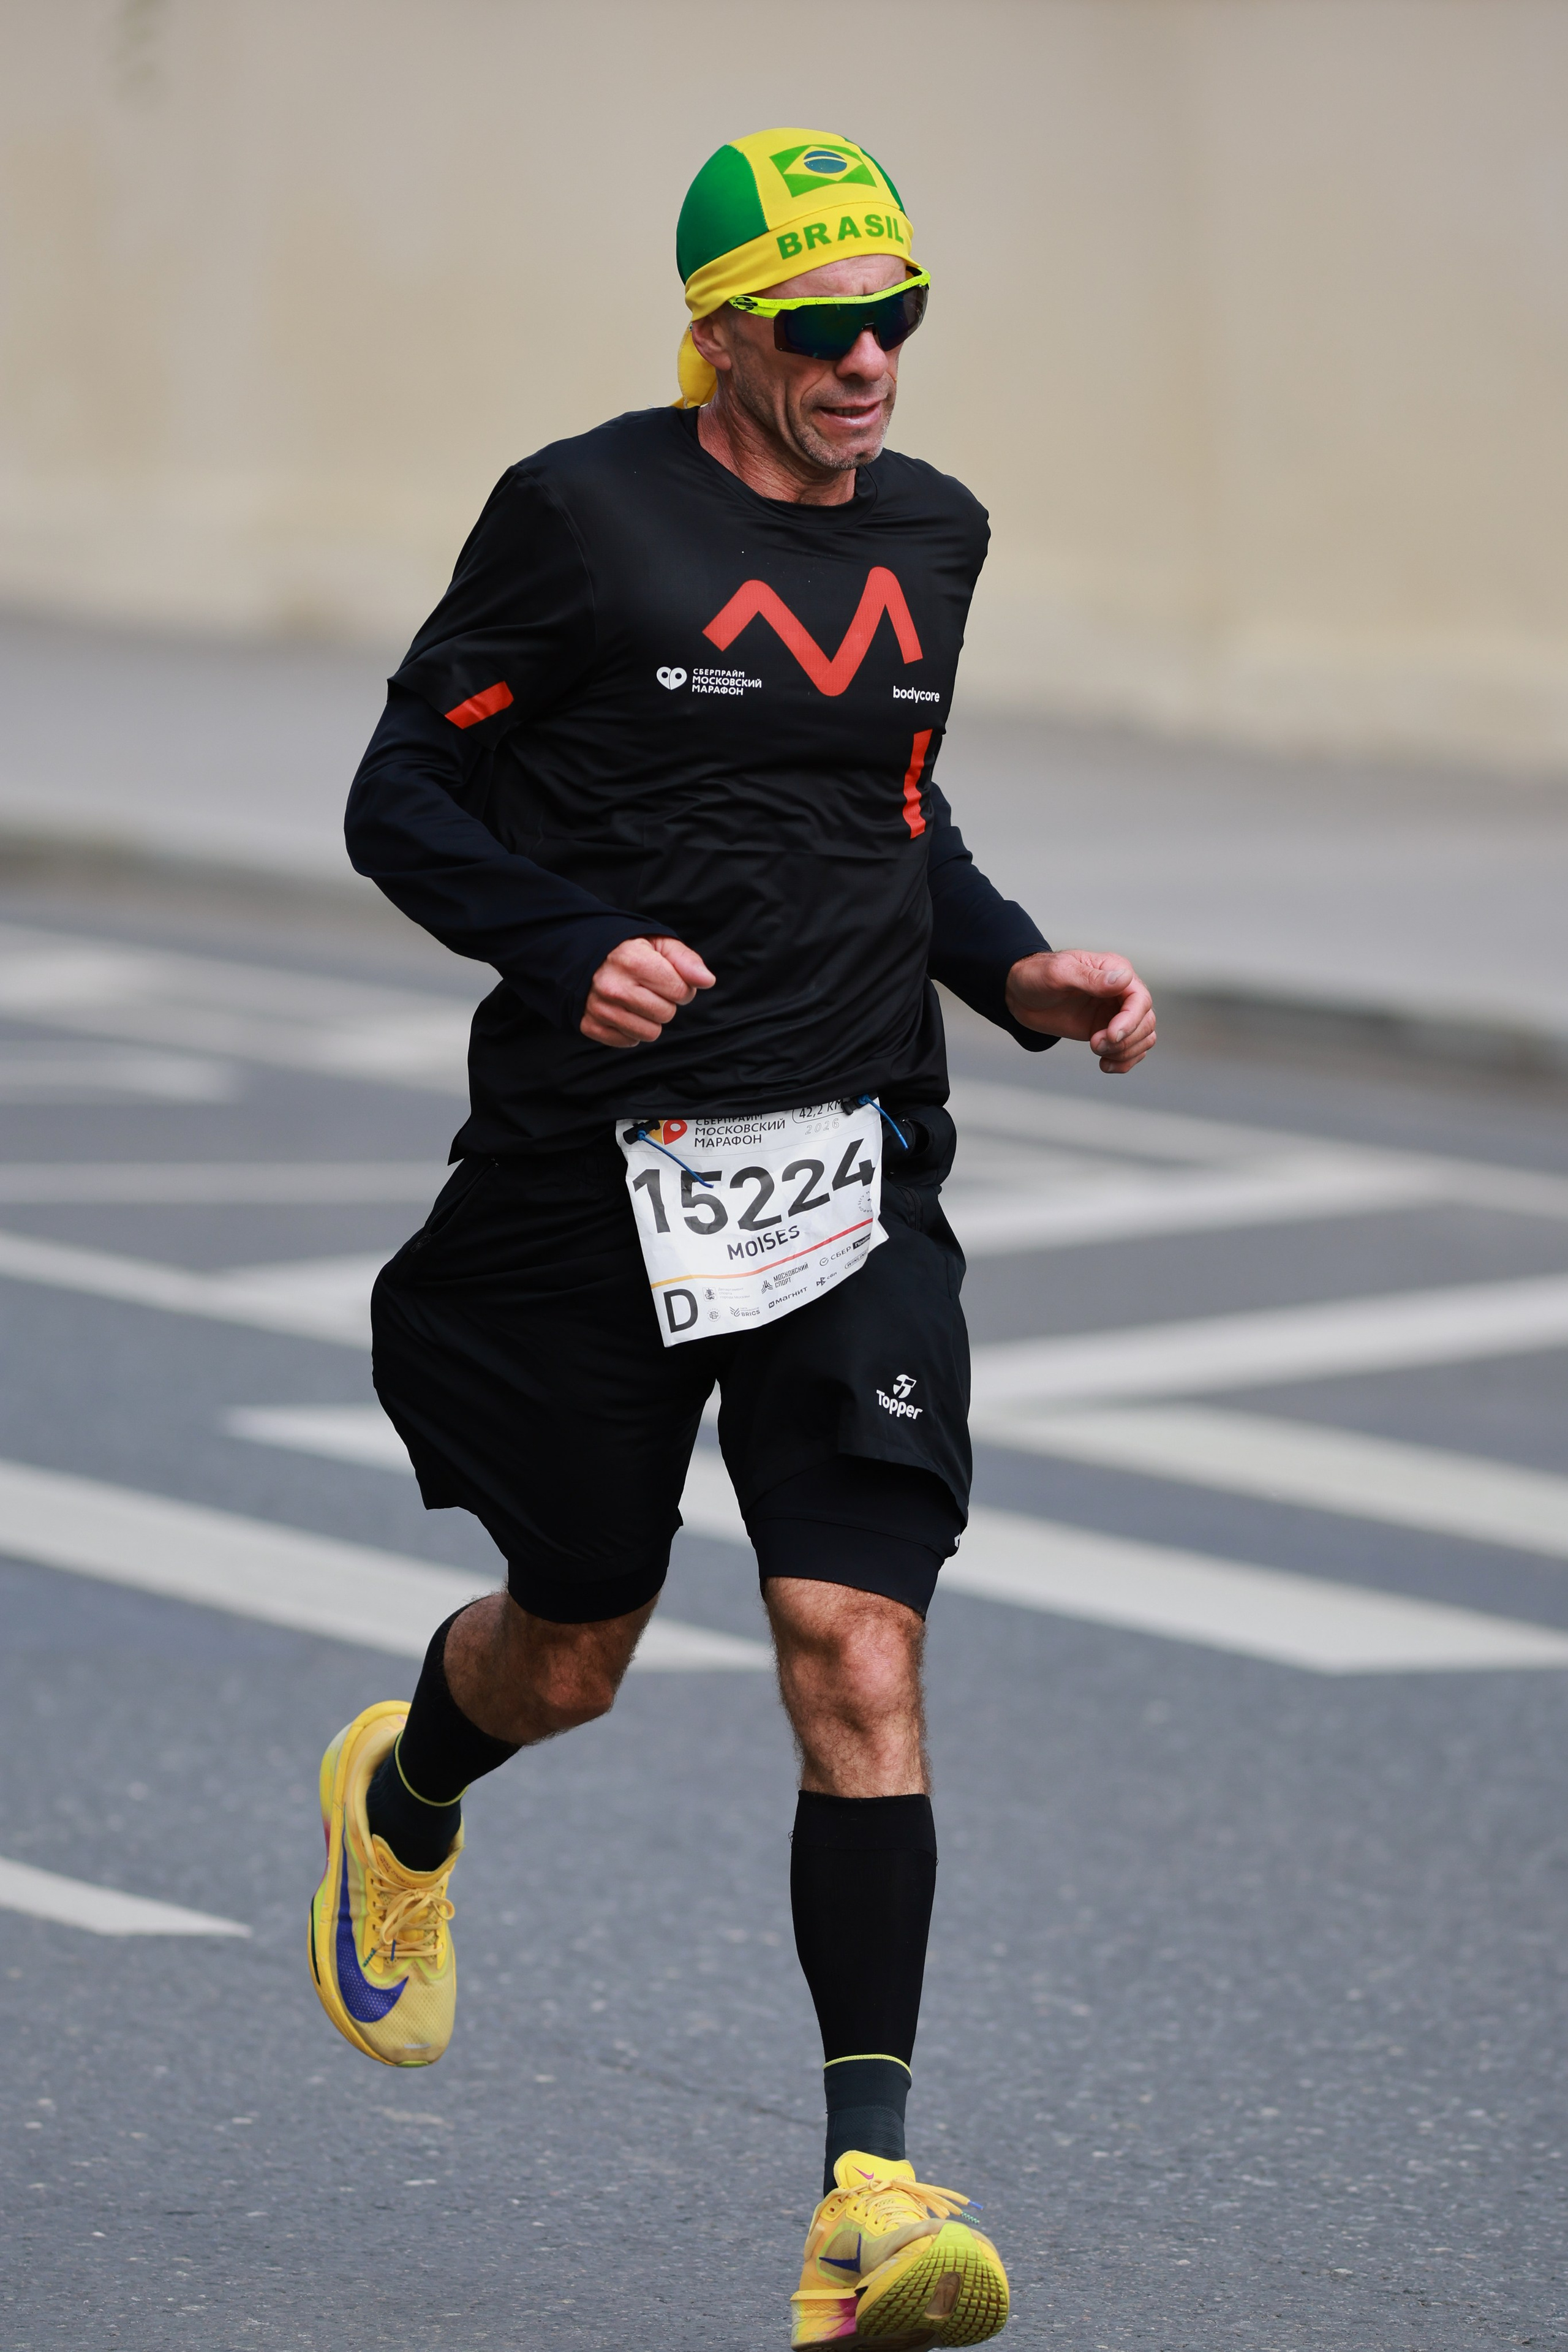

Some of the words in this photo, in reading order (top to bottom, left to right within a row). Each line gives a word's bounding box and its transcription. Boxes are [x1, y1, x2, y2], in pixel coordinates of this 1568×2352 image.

[776, 214, 904, 260] BRASIL
[693, 668, 745, 678] СБЕРПРАЙМ
[692, 676, 762, 688] МОСКОВСКИЙ
[692, 684, 744, 696] МАРАФОН
[893, 685, 940, 703] bodycore
[799, 1104, 823, 1118] 42,2
[695, 1118, 786, 1136] МОСКОВСКИЙ
[805, 1118, 840, 1135] 2026
[694, 1134, 762, 1148] МАРАФОН
[632, 1138, 876, 1235] 15224
[726, 1225, 800, 1260] MOISES
[831, 1246, 851, 1260] СБЕР
[773, 1262, 809, 1283] МОСКОВСКИЙ
[775, 1277, 791, 1288] СПОРТ
[663, 1288, 698, 1333] D
[876, 1390, 923, 1420] Topper
